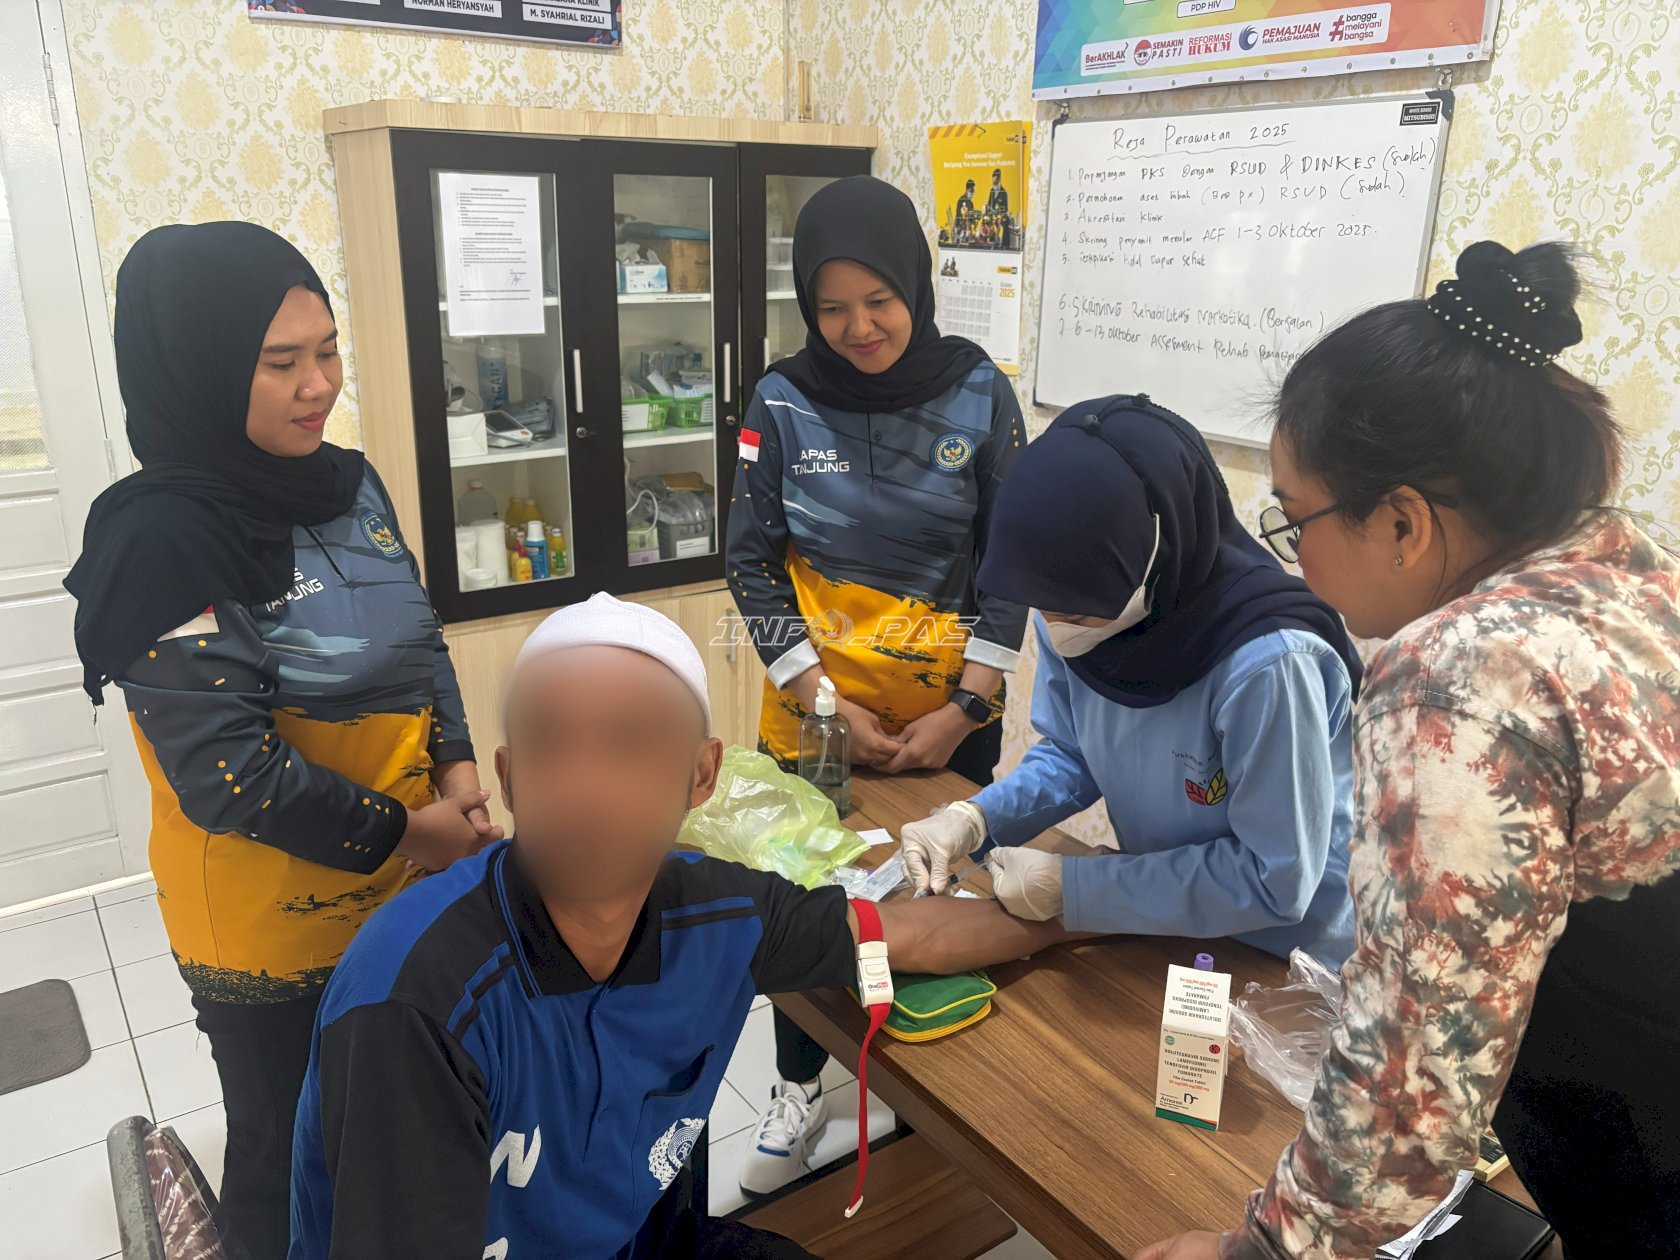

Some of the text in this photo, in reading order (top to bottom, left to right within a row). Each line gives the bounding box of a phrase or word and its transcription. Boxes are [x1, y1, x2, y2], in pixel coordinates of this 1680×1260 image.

[447, 0, 494, 13] HERYANSYAH
[1190, 0, 1221, 12] PDP HIV
[530, 8, 605, 24] M. SYAHRIAL RIZALI
[1346, 12, 1378, 23] bangga
[1262, 22, 1321, 38] PEMAJUAN
[1345, 19, 1383, 31] melayani
[1188, 32, 1233, 45] REFORMASI
[1262, 32, 1320, 45] HAK ASASI MANUSIA
[1344, 31, 1374, 41] bangsa
[1152, 38, 1184, 50] SEMAKIN
[1188, 41, 1232, 56] HUKUM
[1085, 49, 1126, 64] BerAKHLAK
[1151, 48, 1182, 60] PASTI
[1164, 123, 1231, 153] Perawatan
[1249, 122, 1291, 141] 2025
[1141, 167, 1165, 181] PKS
[1229, 160, 1268, 177] RSUD
[1301, 155, 1377, 174] DINKES
[1139, 193, 1160, 202] aset
[1280, 186, 1328, 201] RSUD
[1202, 228, 1226, 242] ACF
[1268, 221, 1326, 239] Oktober
[1000, 287, 1015, 298] 2025
[1213, 338, 1249, 360] Rehab
[799, 448, 838, 461] APAS
